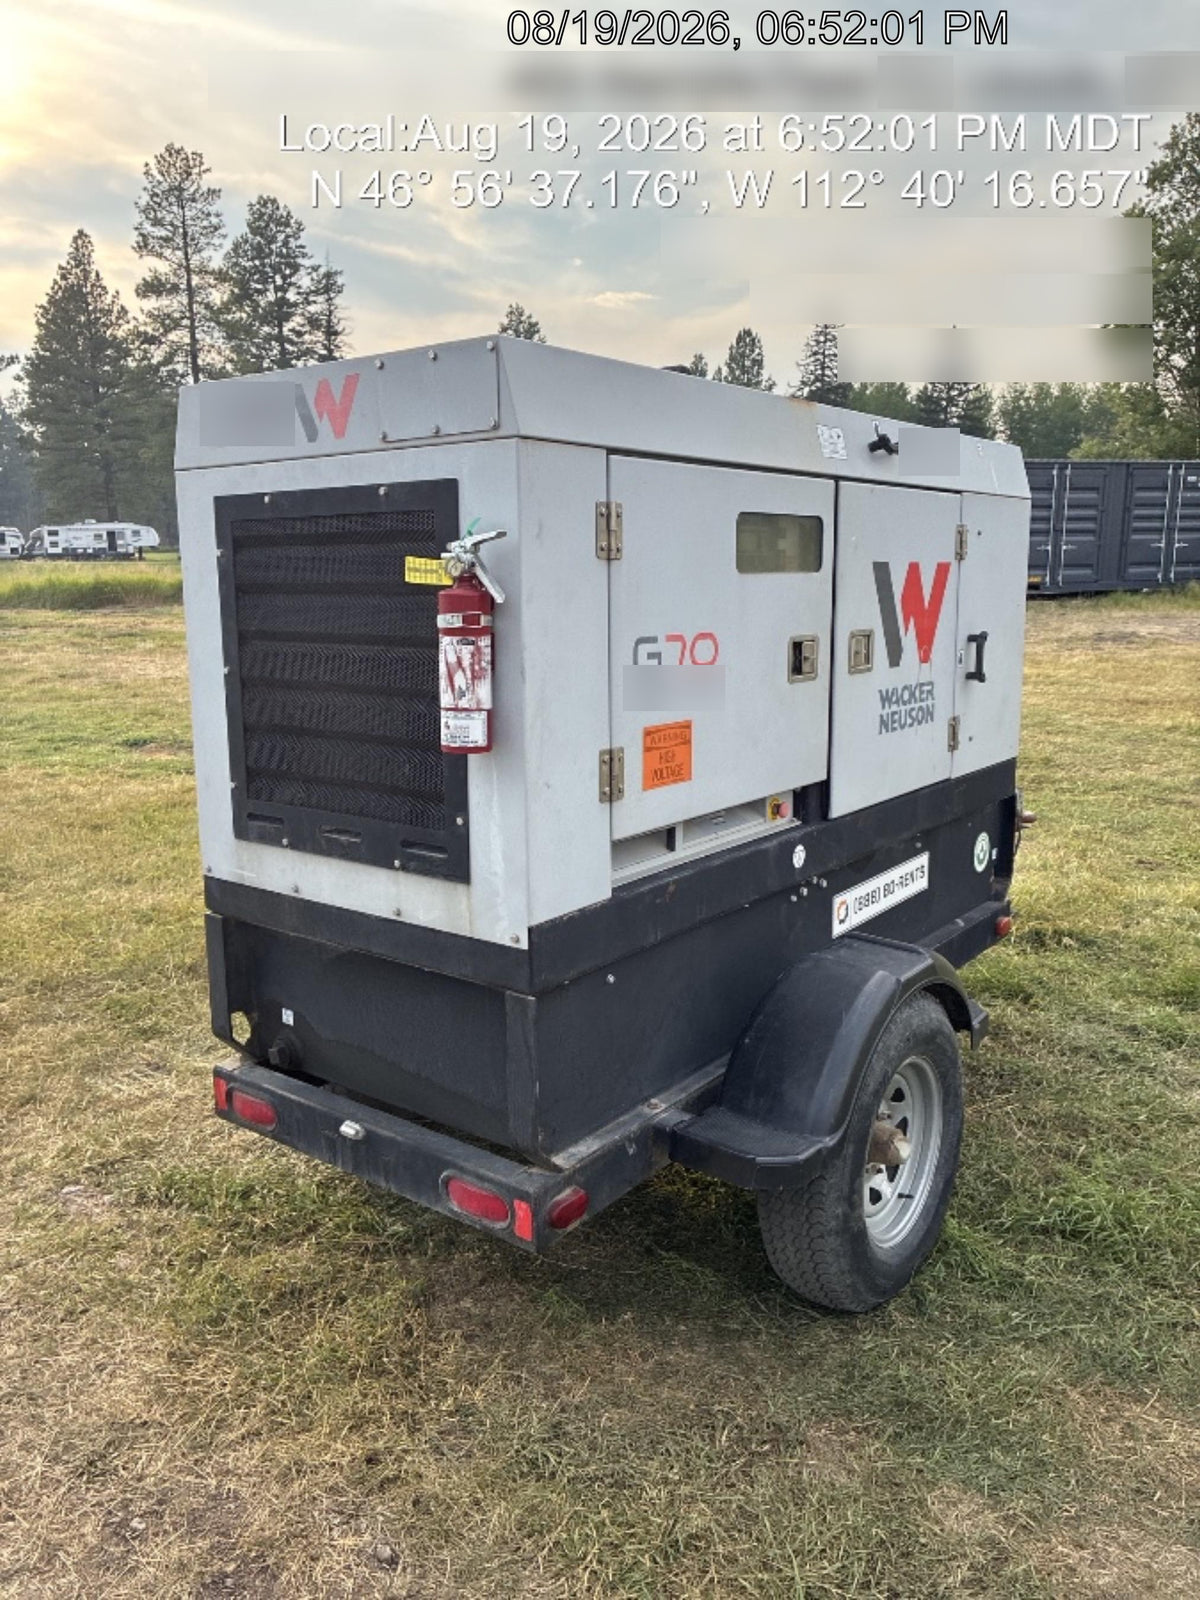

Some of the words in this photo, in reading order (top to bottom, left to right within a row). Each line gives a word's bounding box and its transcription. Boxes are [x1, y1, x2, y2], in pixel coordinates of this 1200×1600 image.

[633, 632, 719, 665] G70
[878, 680, 935, 710] WACKER
[879, 703, 935, 735] NEUSON
[651, 763, 684, 782] VOLTAGE
